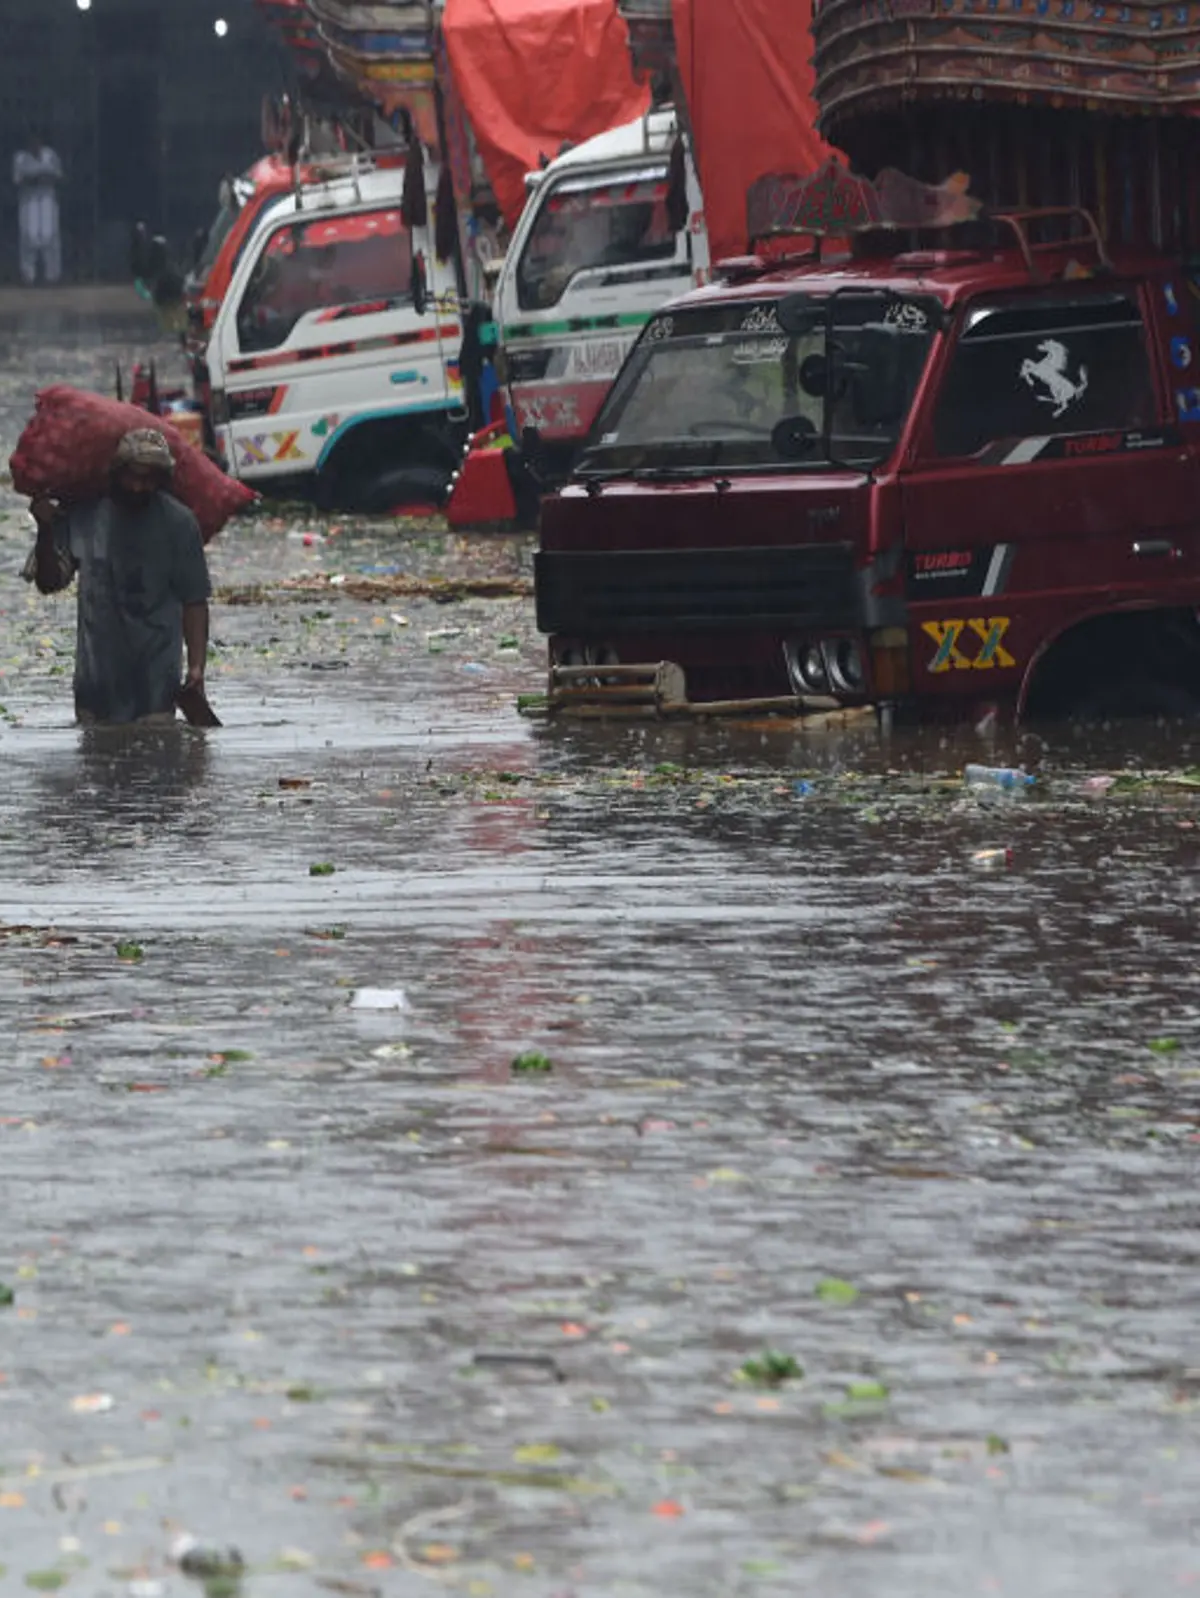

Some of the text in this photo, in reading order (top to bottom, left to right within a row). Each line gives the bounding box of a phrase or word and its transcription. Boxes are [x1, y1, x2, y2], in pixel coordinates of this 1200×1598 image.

[233, 430, 306, 466] XX
[914, 551, 972, 570] TURBO
[921, 616, 1016, 673] XX
